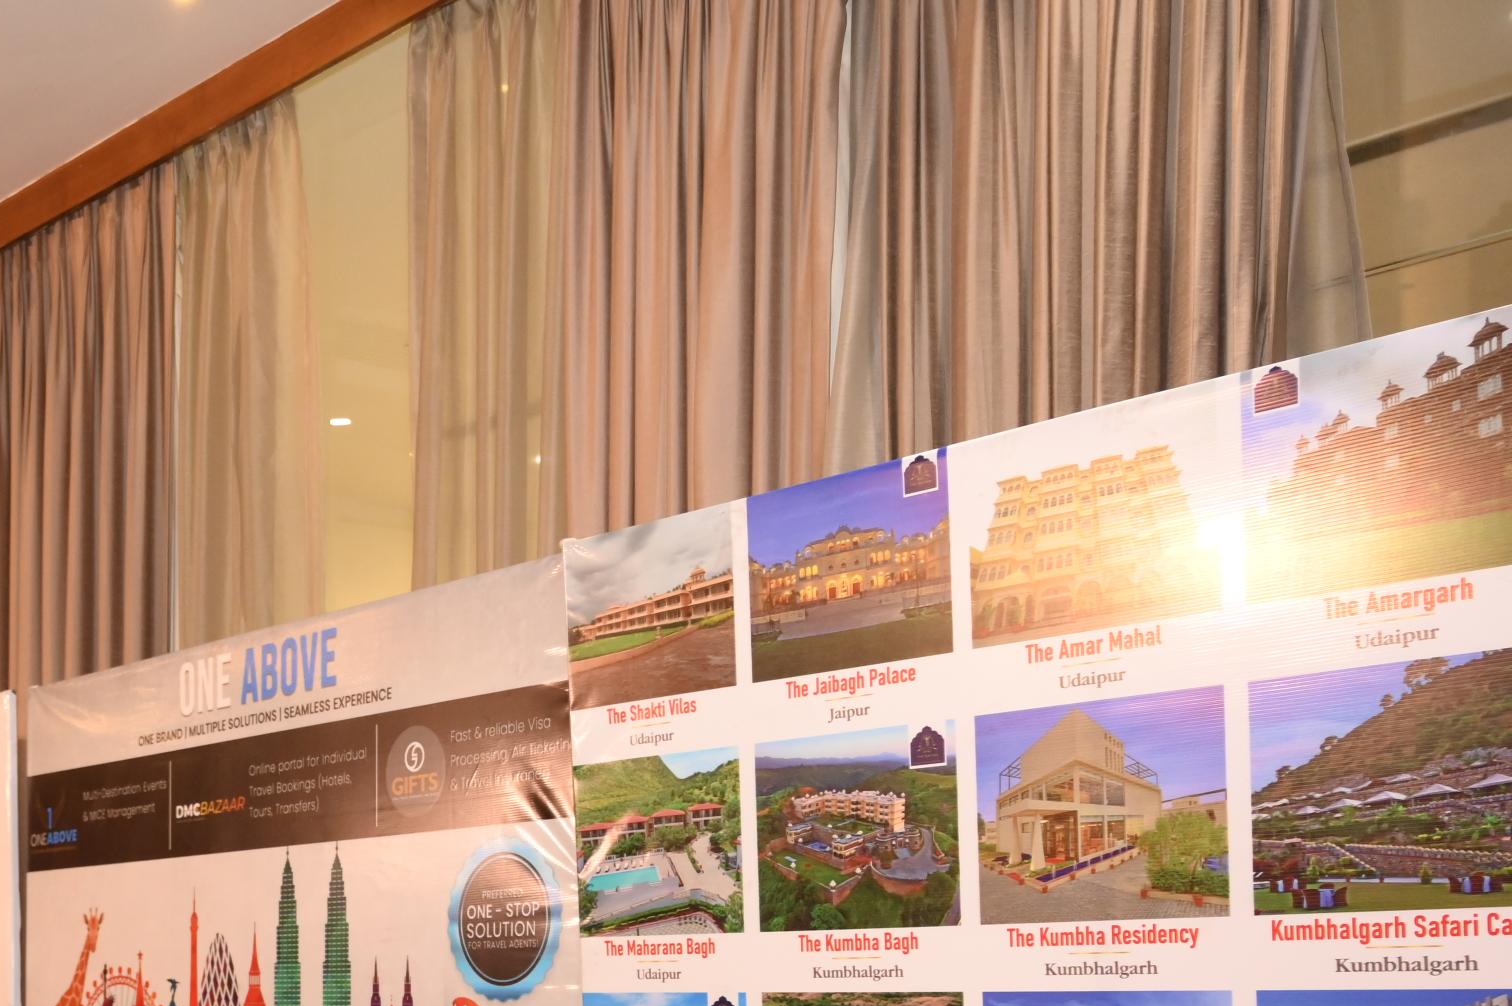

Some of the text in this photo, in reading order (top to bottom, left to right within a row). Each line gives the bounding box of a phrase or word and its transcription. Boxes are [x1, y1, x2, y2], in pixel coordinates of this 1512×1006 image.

[1324, 577, 1475, 621] The Amargarh
[1025, 624, 1162, 665] The Amar Mahal
[1354, 625, 1440, 650] Udaipur
[179, 628, 337, 717] ONE ABOVE
[786, 665, 916, 699] The Jaibagh Palace
[1058, 668, 1126, 691] Udaipur
[138, 687, 393, 748] ONE BRAND MULTIPLE SOLUTIONS SEAMLESS EXPERIENCE
[607, 699, 697, 725] The Shakti Vilas
[827, 704, 871, 723] Jaipur
[450, 717, 551, 743] Fast & reliable Visa
[629, 730, 675, 749] Udaipur
[529, 738, 571, 755] Ticketin
[248, 763, 276, 777] Online
[278, 758, 305, 776] portal
[307, 755, 321, 768] for
[143, 779, 167, 793] Events
[248, 783, 274, 797] Travel
[276, 778, 316, 795] Bookings
[391, 772, 439, 796] GIFTS
[450, 778, 458, 791] &
[175, 796, 247, 820] DMCBAZAAR
[275, 796, 320, 815] Transfers)
[30, 829, 78, 848] ONEABOVE
[466, 904, 493, 920] ONE
[506, 901, 540, 918] STOP
[466, 920, 536, 939] SOLUTION
[1007, 924, 1199, 949] The Kumbha Residency
[1271, 916, 1406, 945] Kumbhalgarh
[1414, 913, 1479, 938] Safari
[467, 940, 481, 950] FOR
[483, 940, 507, 949] TRAVEL
[604, 937, 715, 959] The Maharana Bagh
[798, 931, 918, 955] The Kumbha Bagh
[636, 968, 681, 985] Udaipur
[812, 964, 904, 982] Kumbhalgarh
[1044, 960, 1158, 979] Kumbhalgarh
[1335, 956, 1479, 977] Kumbhalgarh
